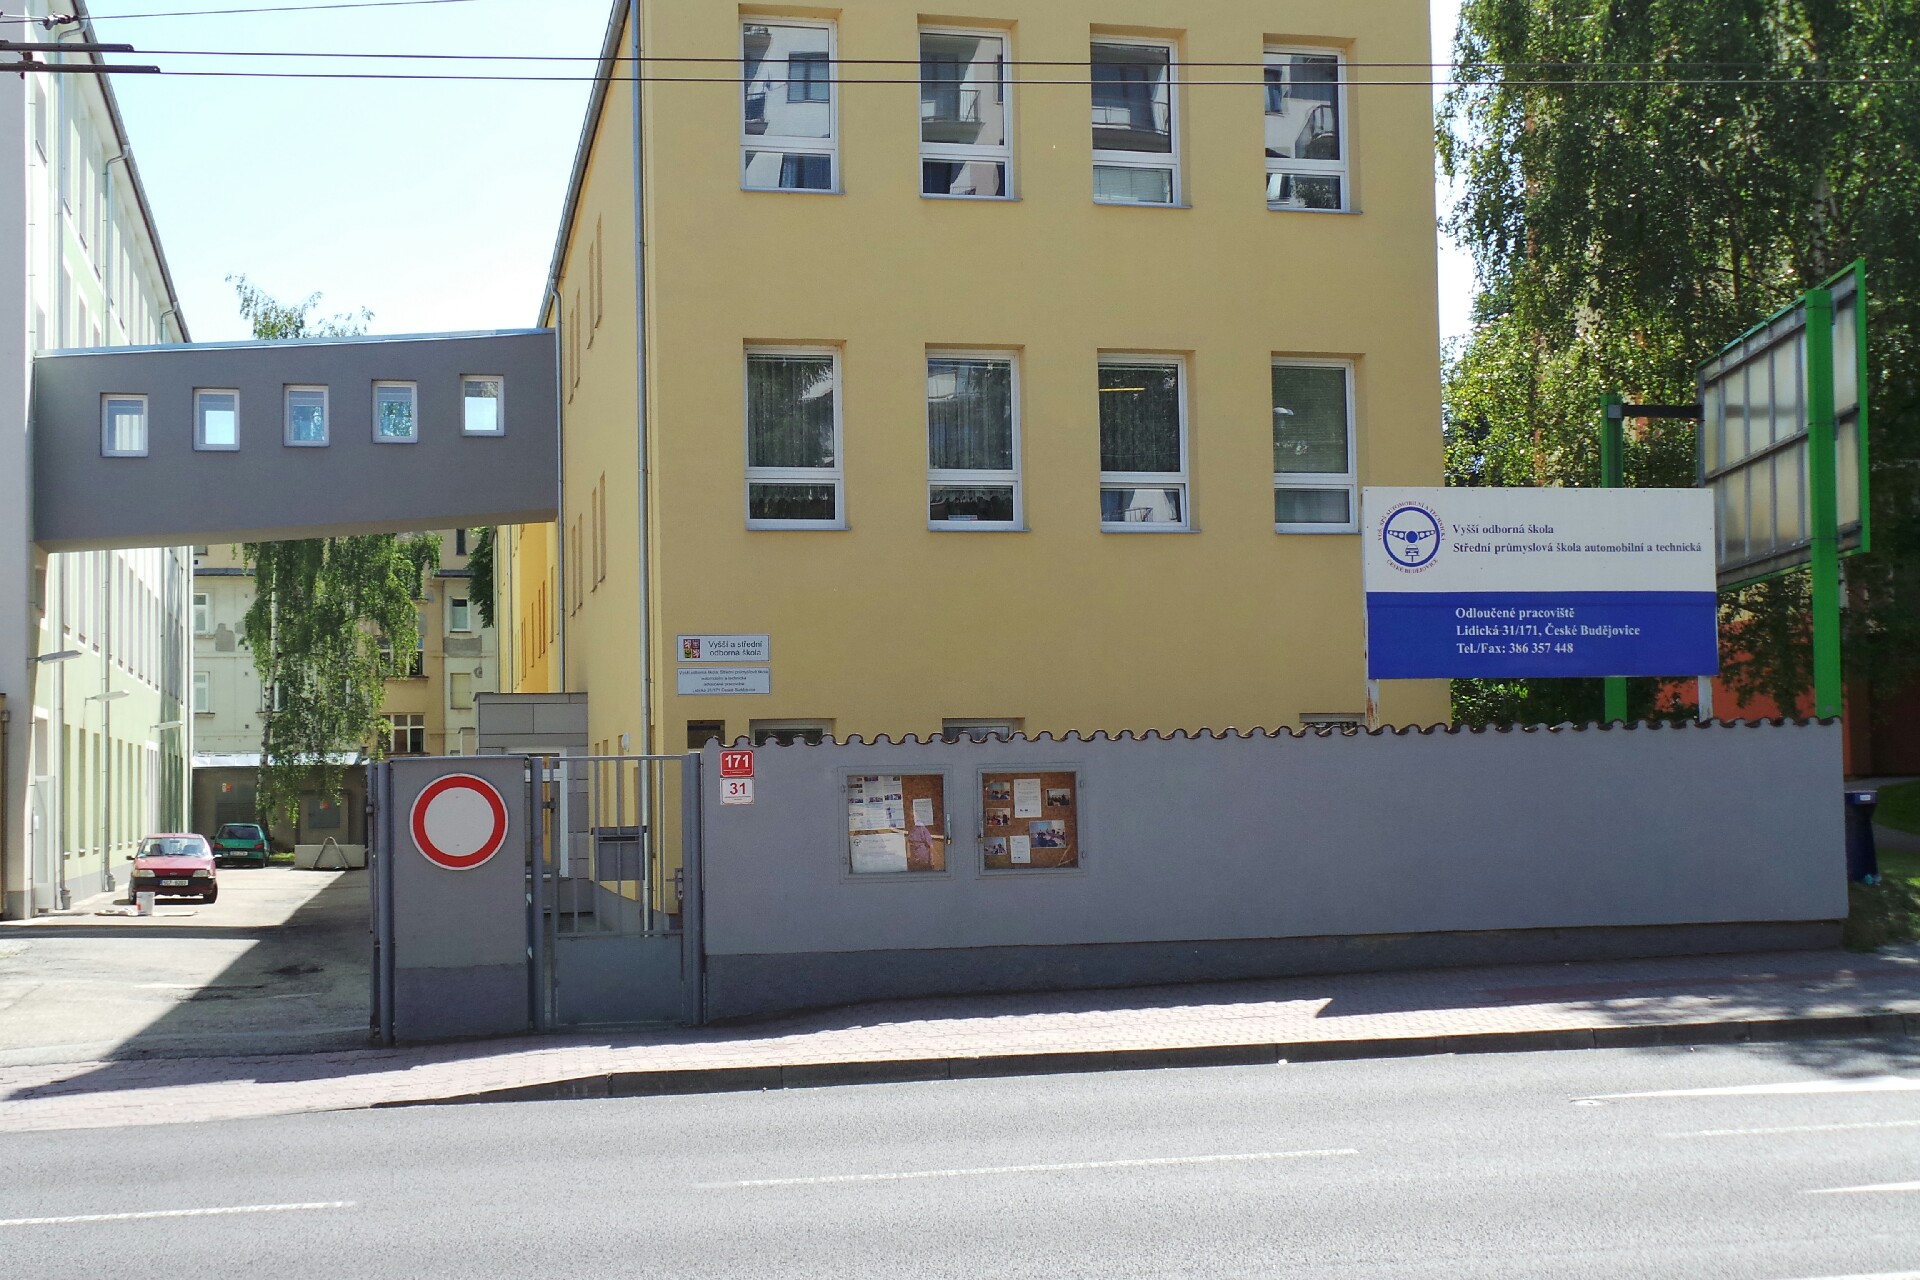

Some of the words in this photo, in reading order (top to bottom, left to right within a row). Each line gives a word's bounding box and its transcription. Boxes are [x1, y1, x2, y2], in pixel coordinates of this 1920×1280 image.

[1453, 524, 1479, 536] Vyšší
[1482, 524, 1525, 534] odborná
[1528, 524, 1554, 534] škola
[1453, 542, 1491, 552] Střední
[1494, 542, 1553, 555] průmyslová
[1556, 542, 1582, 552] škola
[1584, 542, 1644, 552] automobilní
[1656, 542, 1702, 552] technická
[1455, 607, 1515, 618] Odloučené
[1519, 607, 1575, 620] pracoviště
[1456, 625, 1499, 636] Lidická
[1502, 625, 1542, 637] 31/171,
[1545, 623, 1577, 636] České
[1580, 625, 1640, 638] Budějovice
[708, 641, 729, 649] Vyšší
[1456, 643, 1506, 654] Tel./Fax:
[1509, 643, 1529, 654] 386
[1531, 643, 1551, 653] 357
[1554, 643, 1574, 653] 448
[725, 754, 749, 768] 171
[729, 782, 746, 795] 31
